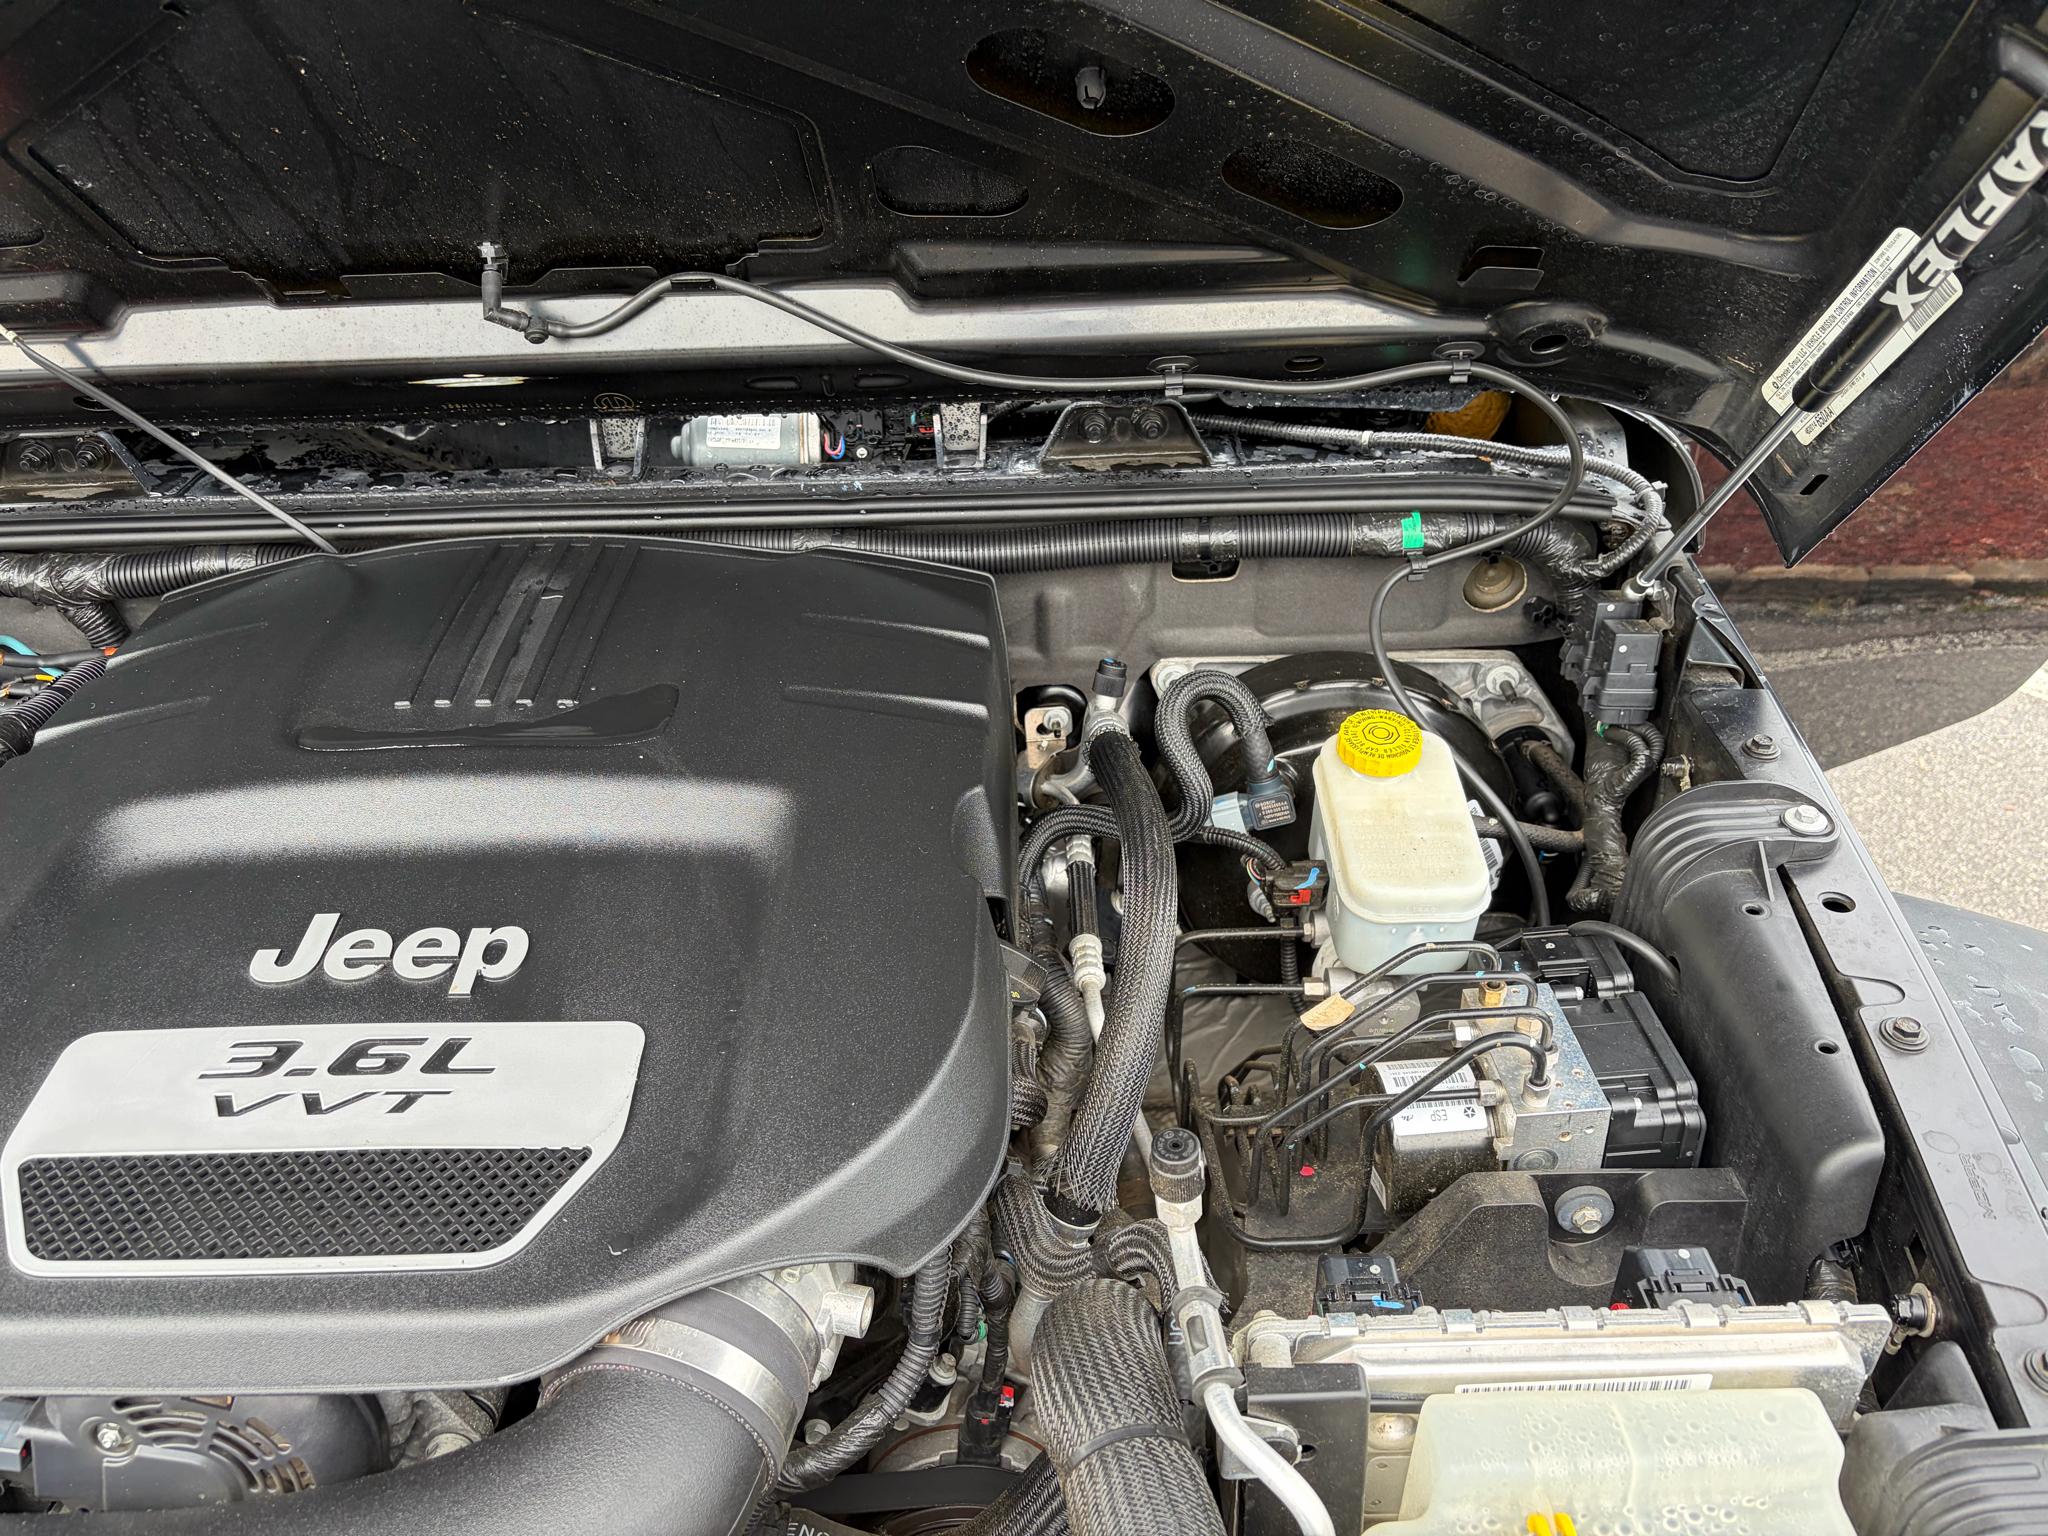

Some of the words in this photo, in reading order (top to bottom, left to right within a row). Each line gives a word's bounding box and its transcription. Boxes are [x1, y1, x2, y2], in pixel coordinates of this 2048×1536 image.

[1806, 327, 1823, 350] VEHICLE
[1817, 312, 1838, 334] EMISSION
[1833, 295, 1852, 317] CONTROL
[1849, 267, 1879, 300] INFORMATION
[1776, 365, 1791, 384] Chrysler
[1789, 355, 1800, 372] Group
[1798, 348, 1808, 360] LLC
[250, 912, 529, 995] Jeep
[198, 1037, 497, 1079] 3.6L
[214, 1088, 455, 1117] VVT
[1430, 1109, 1448, 1122] ESP
